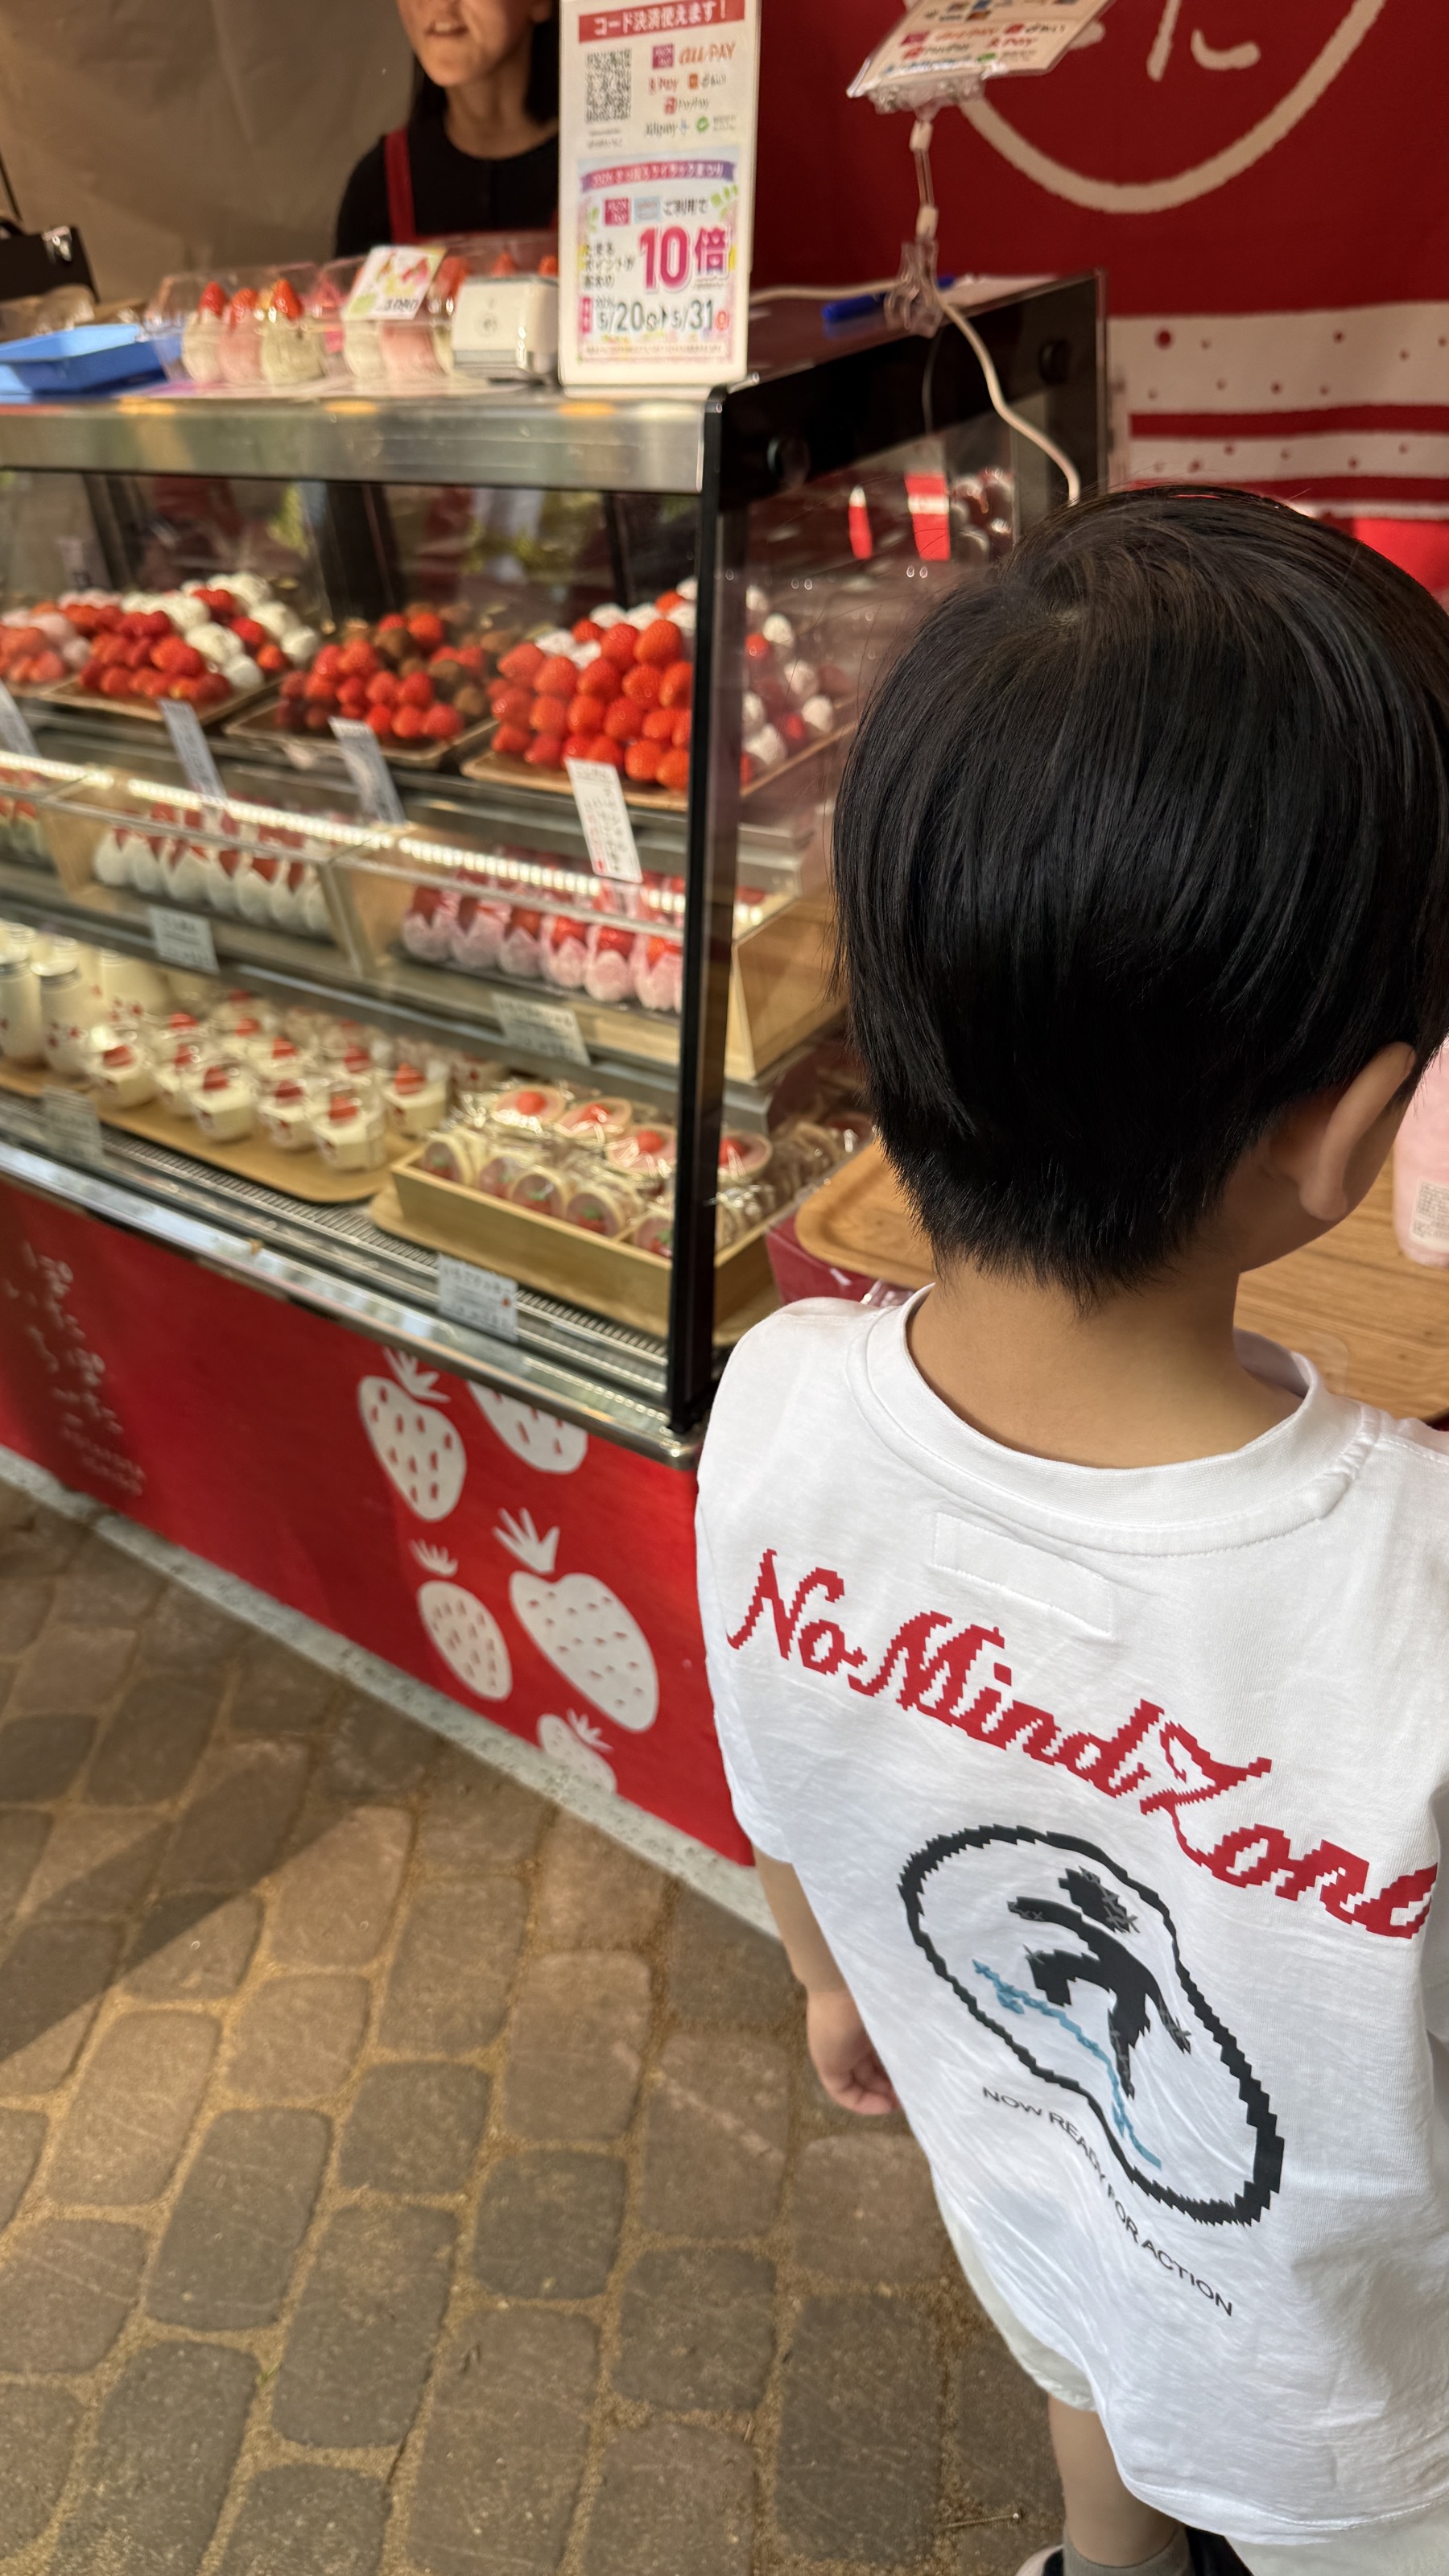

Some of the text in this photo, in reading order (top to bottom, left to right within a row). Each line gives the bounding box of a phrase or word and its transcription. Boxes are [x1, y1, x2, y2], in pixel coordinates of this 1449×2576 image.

[708, 43, 735, 61] PAY
[726, 1548, 868, 1675] No
[848, 1610, 1165, 1798] Mind
[982, 2087, 1042, 2116] NOW
[1141, 2239, 1232, 2317] ACTION
